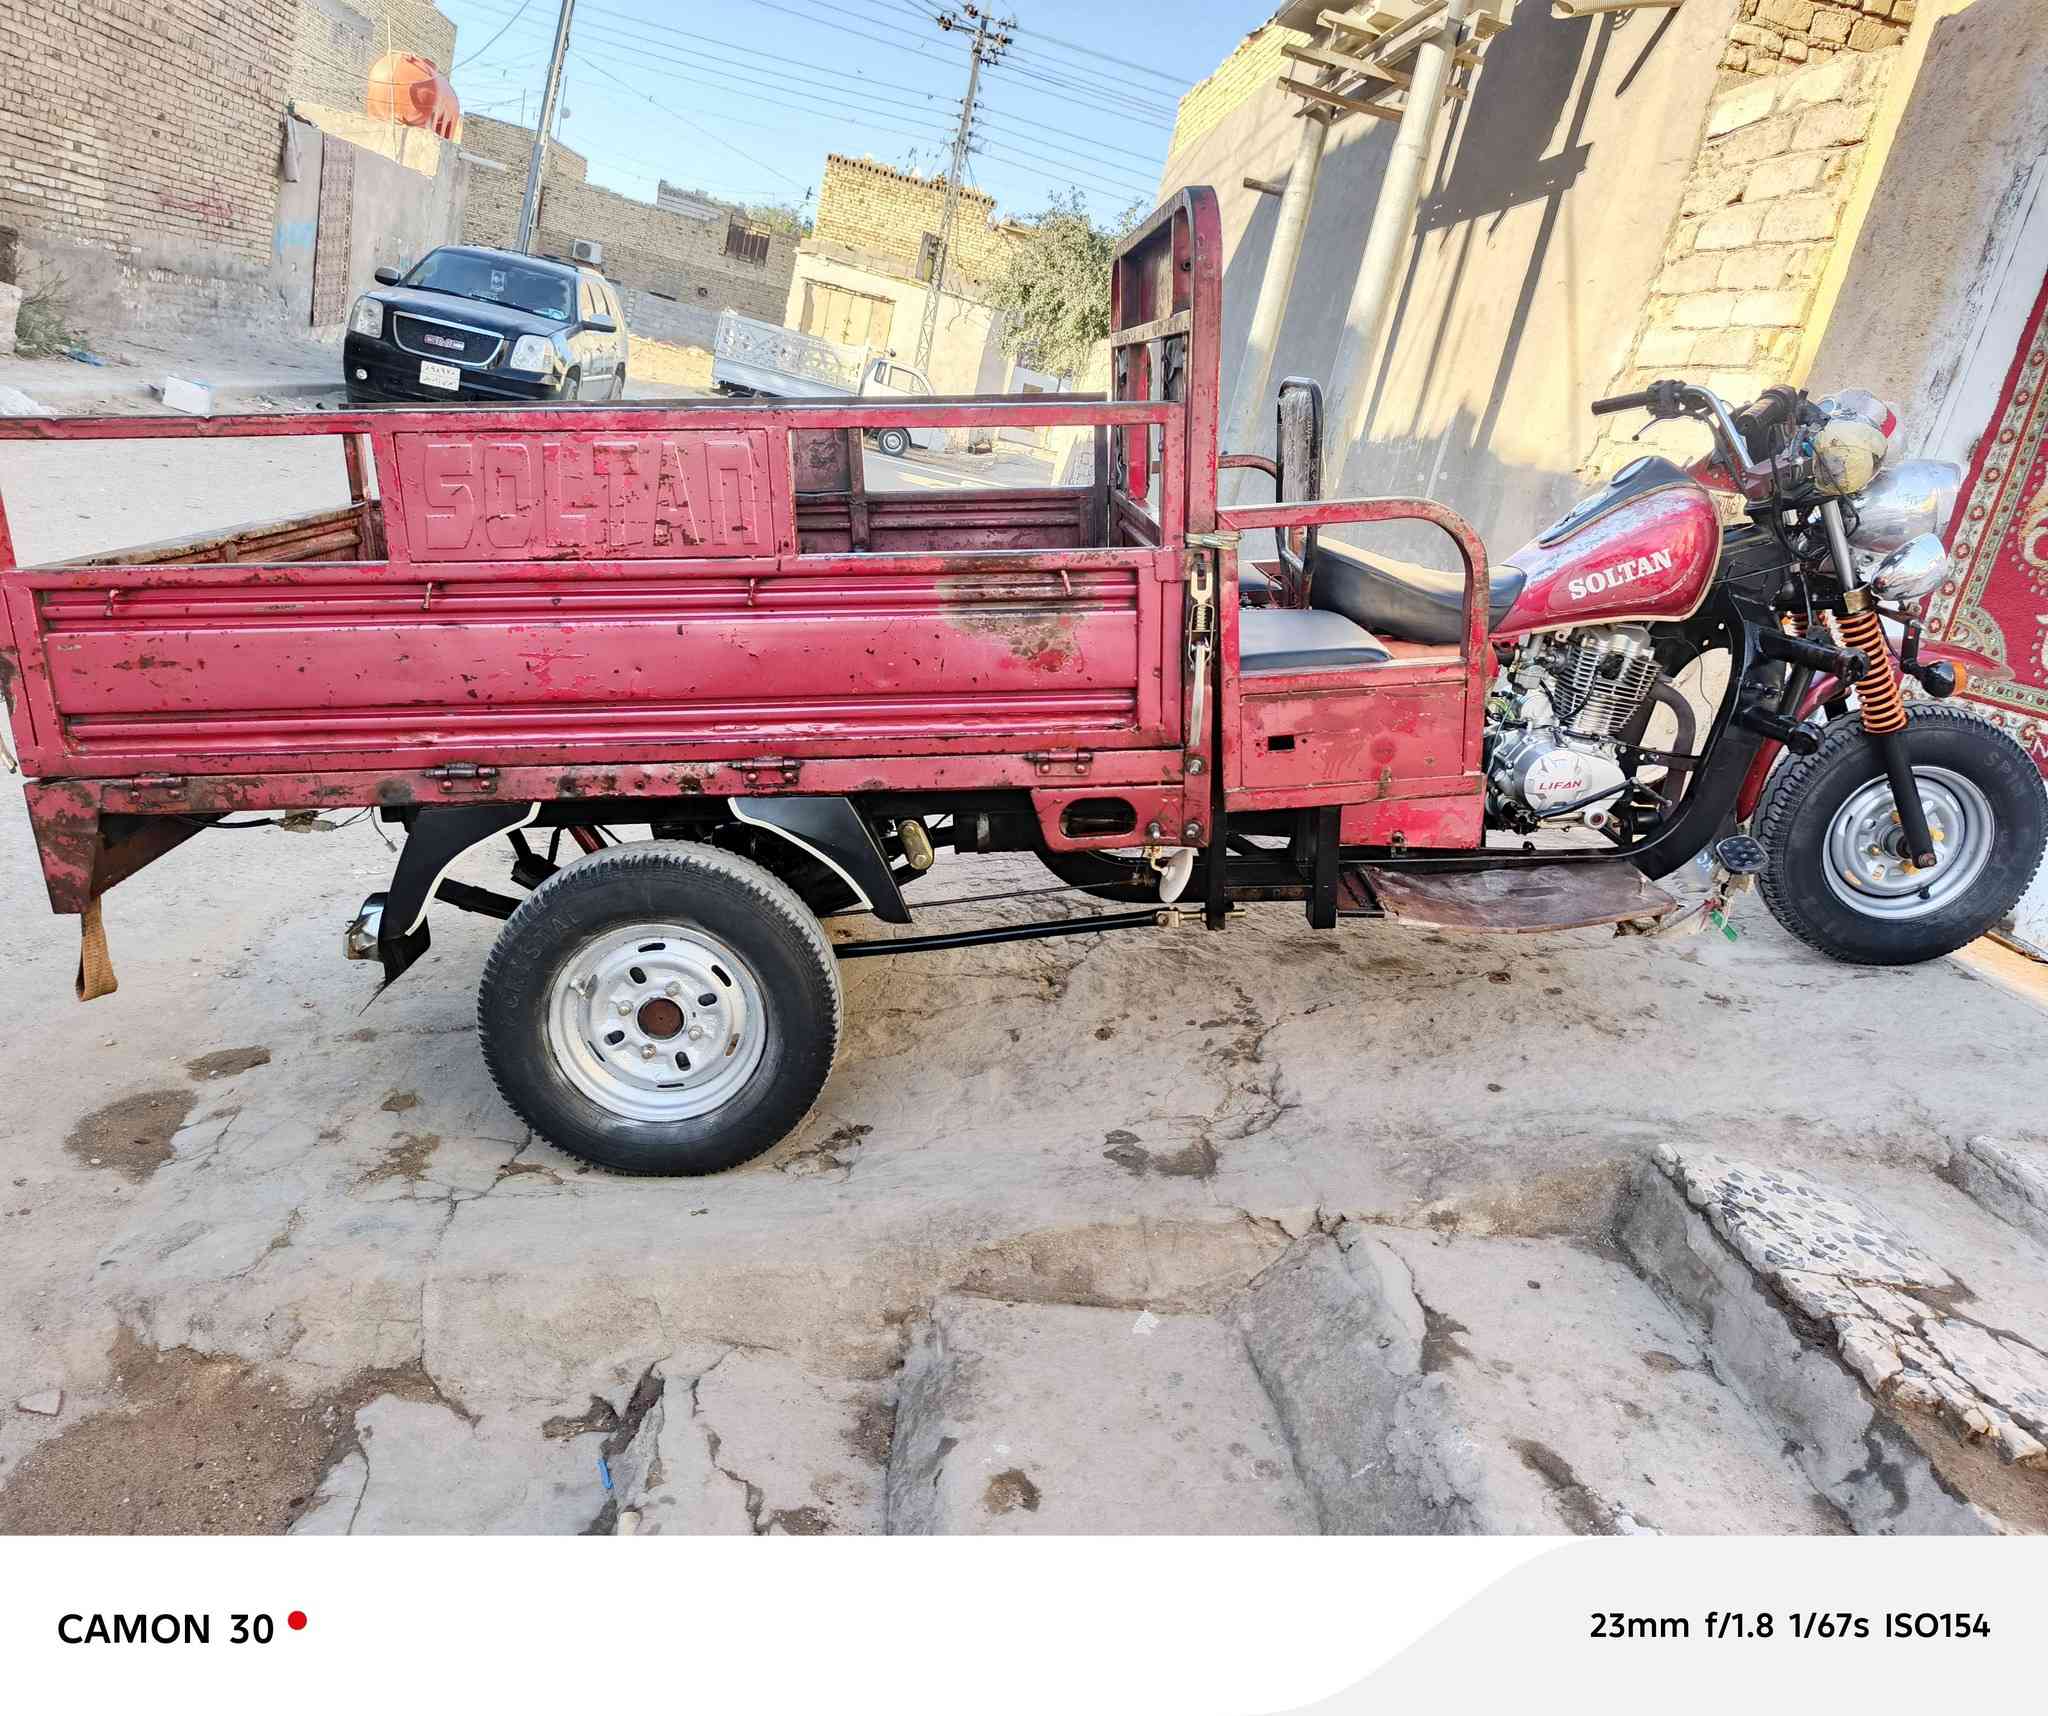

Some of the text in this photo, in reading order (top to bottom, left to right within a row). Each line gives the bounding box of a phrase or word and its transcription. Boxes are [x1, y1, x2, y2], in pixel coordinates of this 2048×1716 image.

[424, 440, 761, 550] SOLTAN
[1568, 548, 1673, 601] SOLTAN
[1539, 779, 1582, 791] LIFAN
